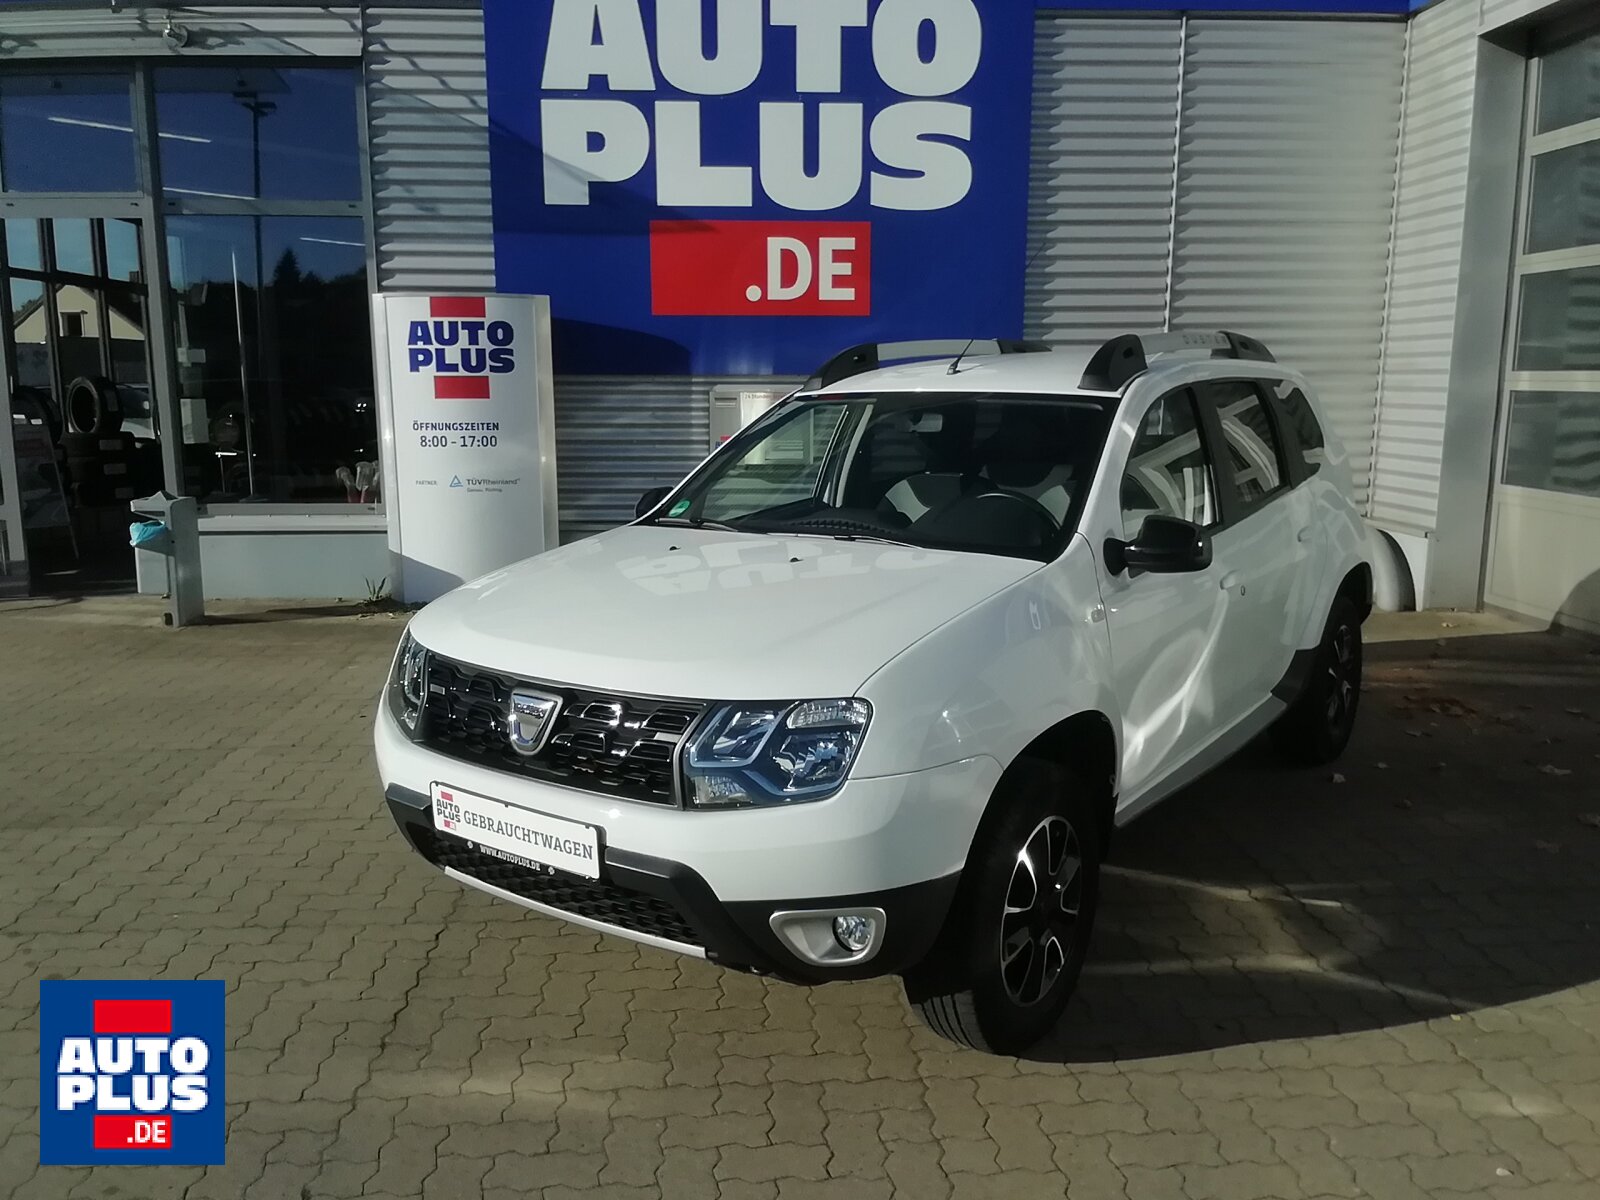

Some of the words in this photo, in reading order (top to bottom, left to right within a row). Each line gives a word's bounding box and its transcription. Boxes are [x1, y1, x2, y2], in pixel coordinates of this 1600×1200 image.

[541, 0, 982, 97] AUTO
[541, 99, 973, 210] PLUS
[745, 236, 856, 302] .DE
[408, 320, 515, 347] AUTO
[408, 348, 516, 374] PLUS
[412, 420, 500, 432] ÖFFNUNGSZEITEN
[419, 435, 448, 448] 8:00
[460, 435, 498, 448] 17:00
[436, 799, 461, 814] AUTO
[436, 808, 462, 823] PLUS
[463, 810, 594, 861] GEBRAUCHTWAGEN
